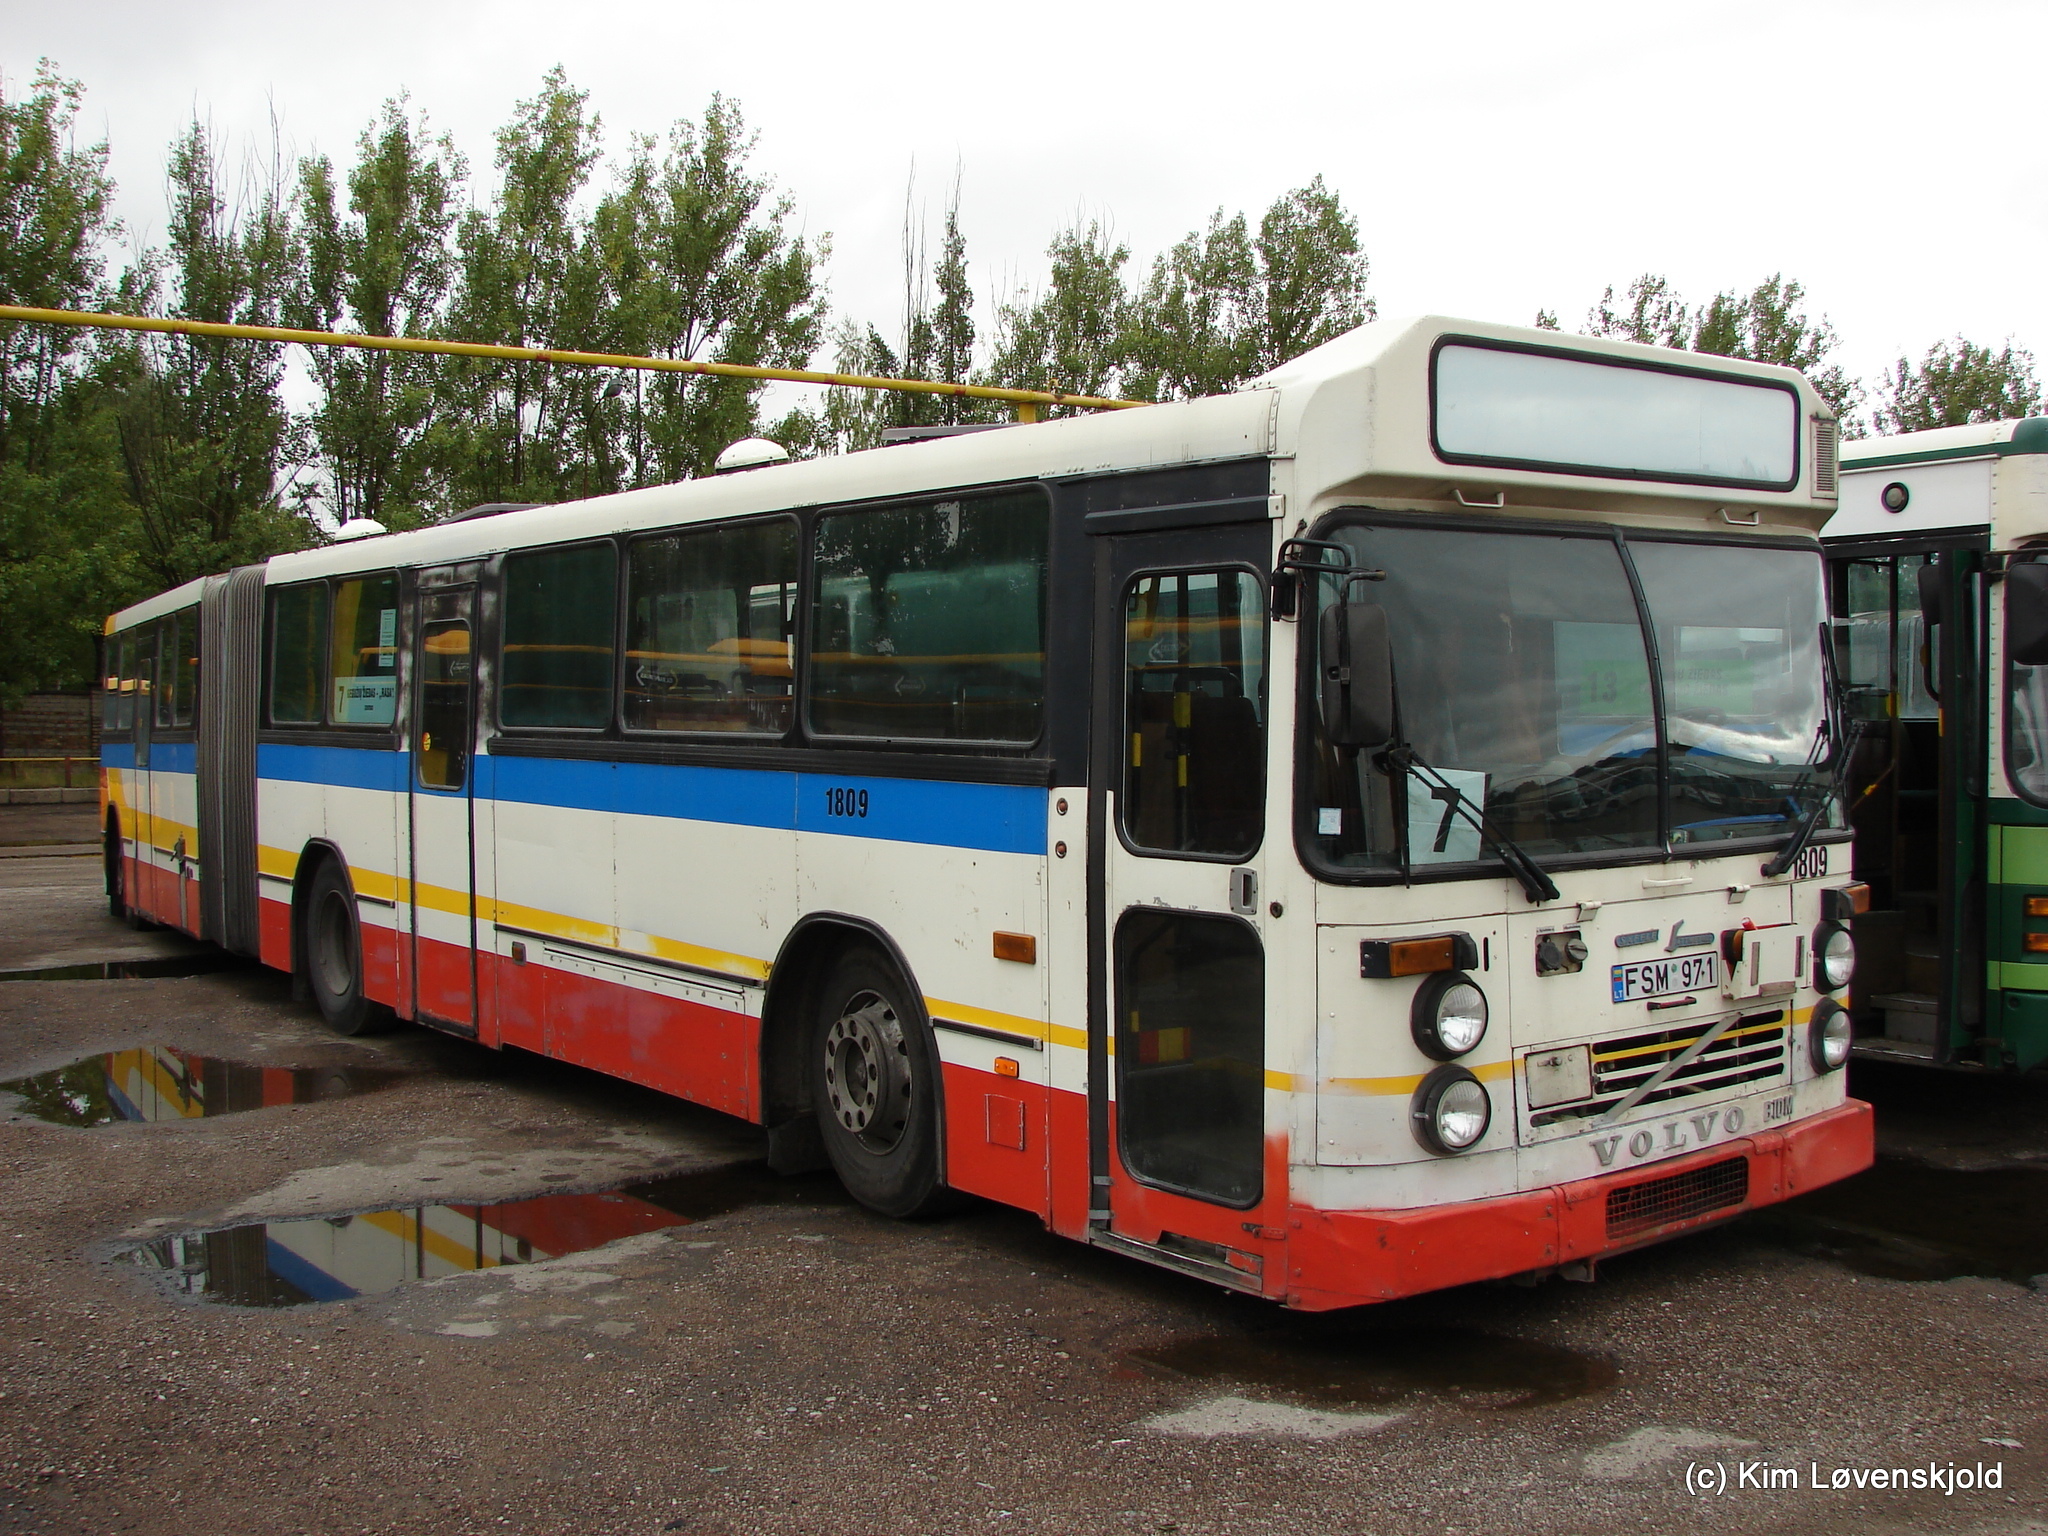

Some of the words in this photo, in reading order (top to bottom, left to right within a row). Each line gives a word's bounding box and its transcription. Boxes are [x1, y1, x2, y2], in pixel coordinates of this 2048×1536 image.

[338, 685, 345, 713] 7
[826, 787, 868, 818] 1809
[1431, 786, 1461, 852] 7
[1794, 846, 1827, 880] 1809
[1625, 963, 1668, 996] FSM
[1682, 957, 1712, 987] 971
[1613, 989, 1623, 999] LT
[1763, 1095, 1793, 1122] B10M
[1589, 1106, 1744, 1166] VOLVO
